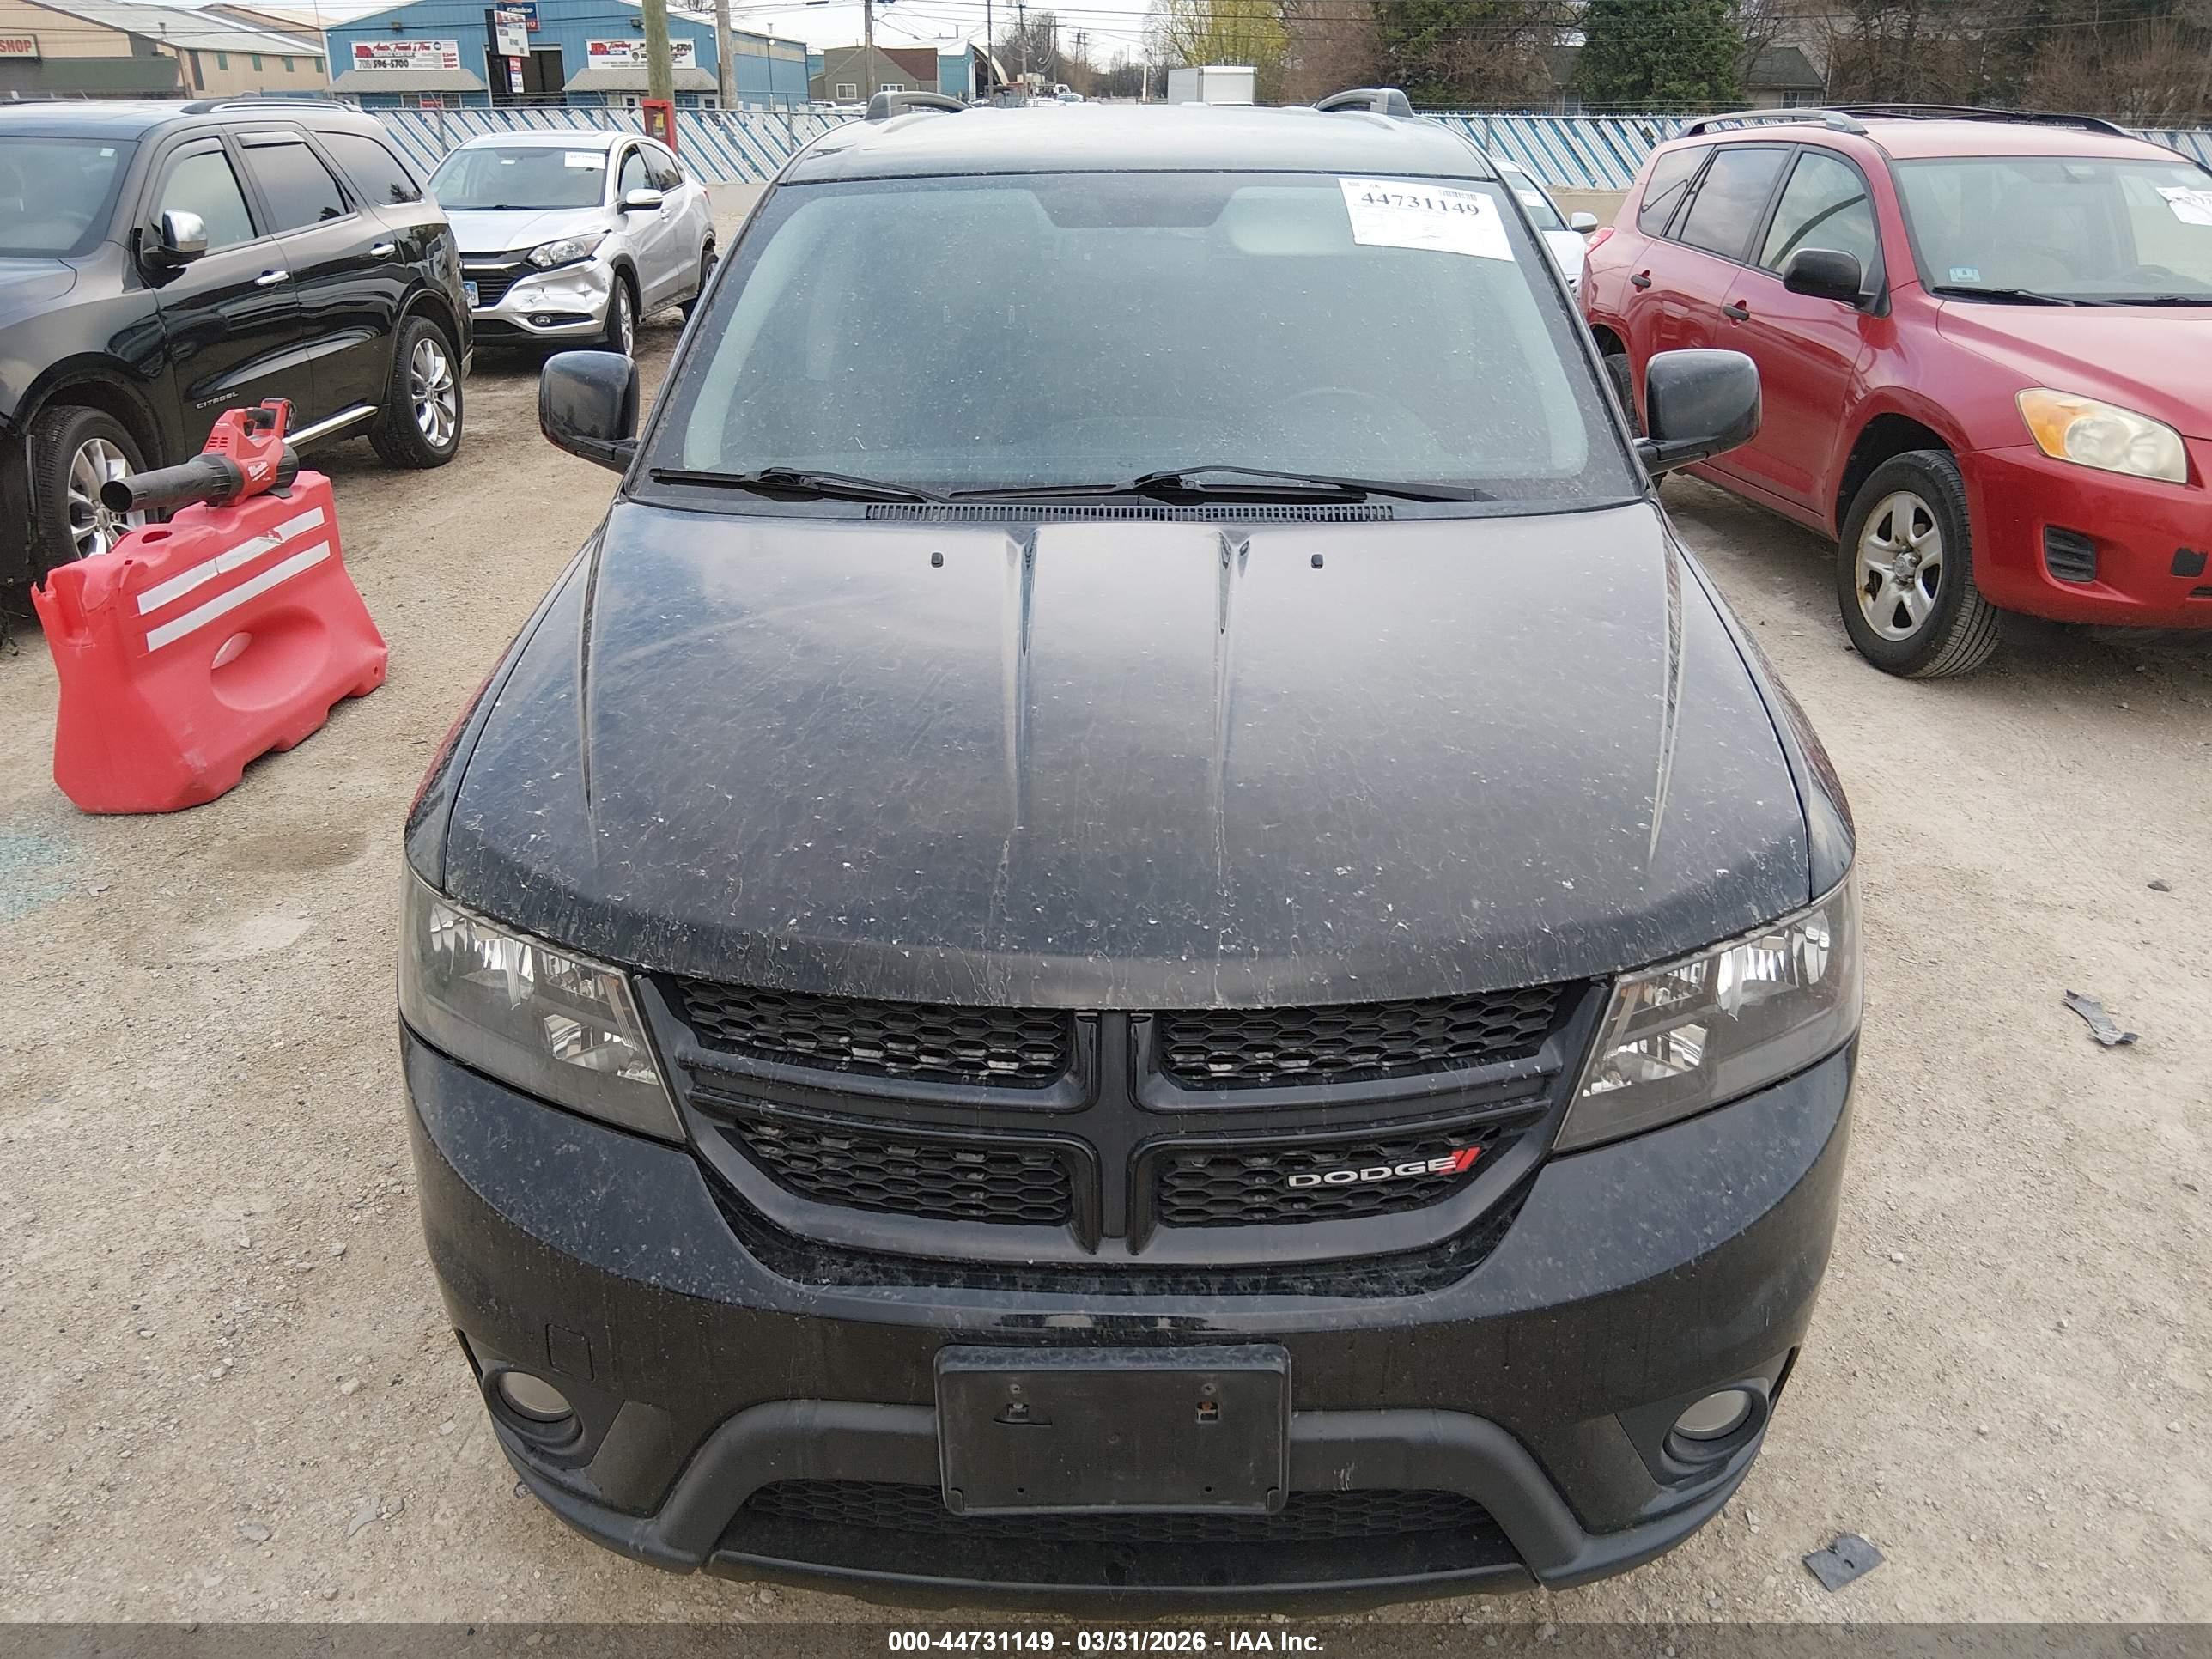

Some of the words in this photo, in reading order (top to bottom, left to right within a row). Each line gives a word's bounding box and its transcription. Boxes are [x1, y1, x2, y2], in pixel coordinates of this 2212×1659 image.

[0, 40, 32, 52] SHOP
[1361, 192, 1480, 216] 44731149
[1288, 1156, 1457, 1188] DODGE
